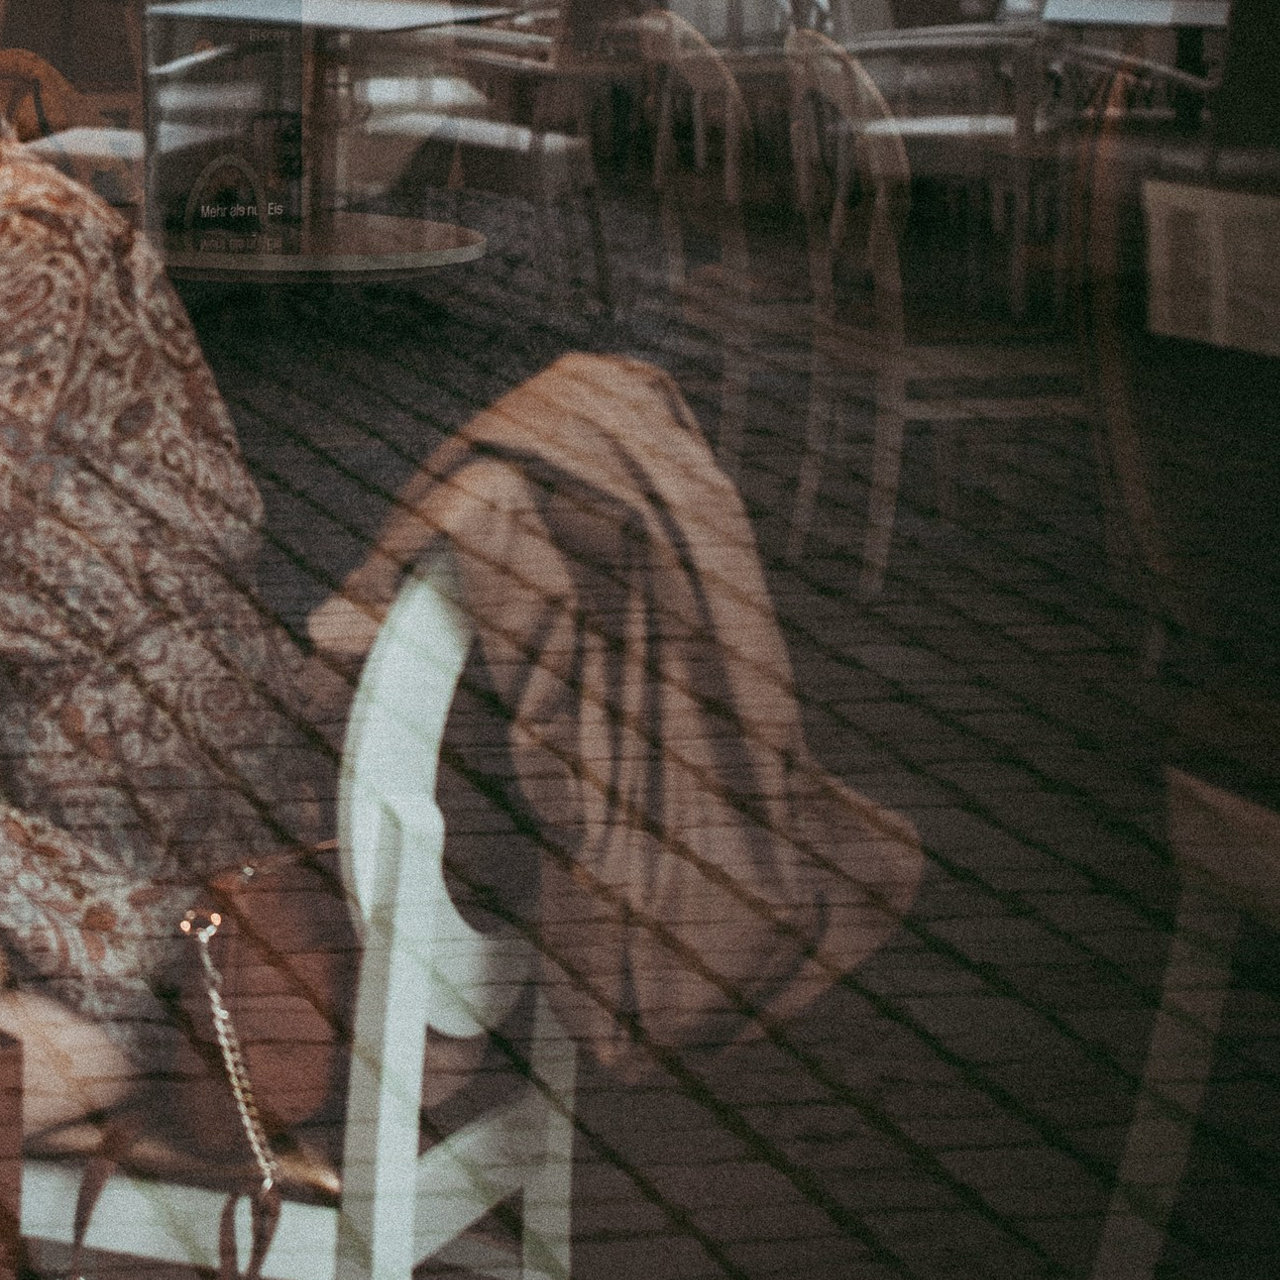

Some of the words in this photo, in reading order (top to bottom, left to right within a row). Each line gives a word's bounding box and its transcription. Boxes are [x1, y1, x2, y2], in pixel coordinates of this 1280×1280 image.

[200, 204, 227, 218] Mehr
[229, 203, 246, 218] als
[267, 202, 284, 216] Eis
